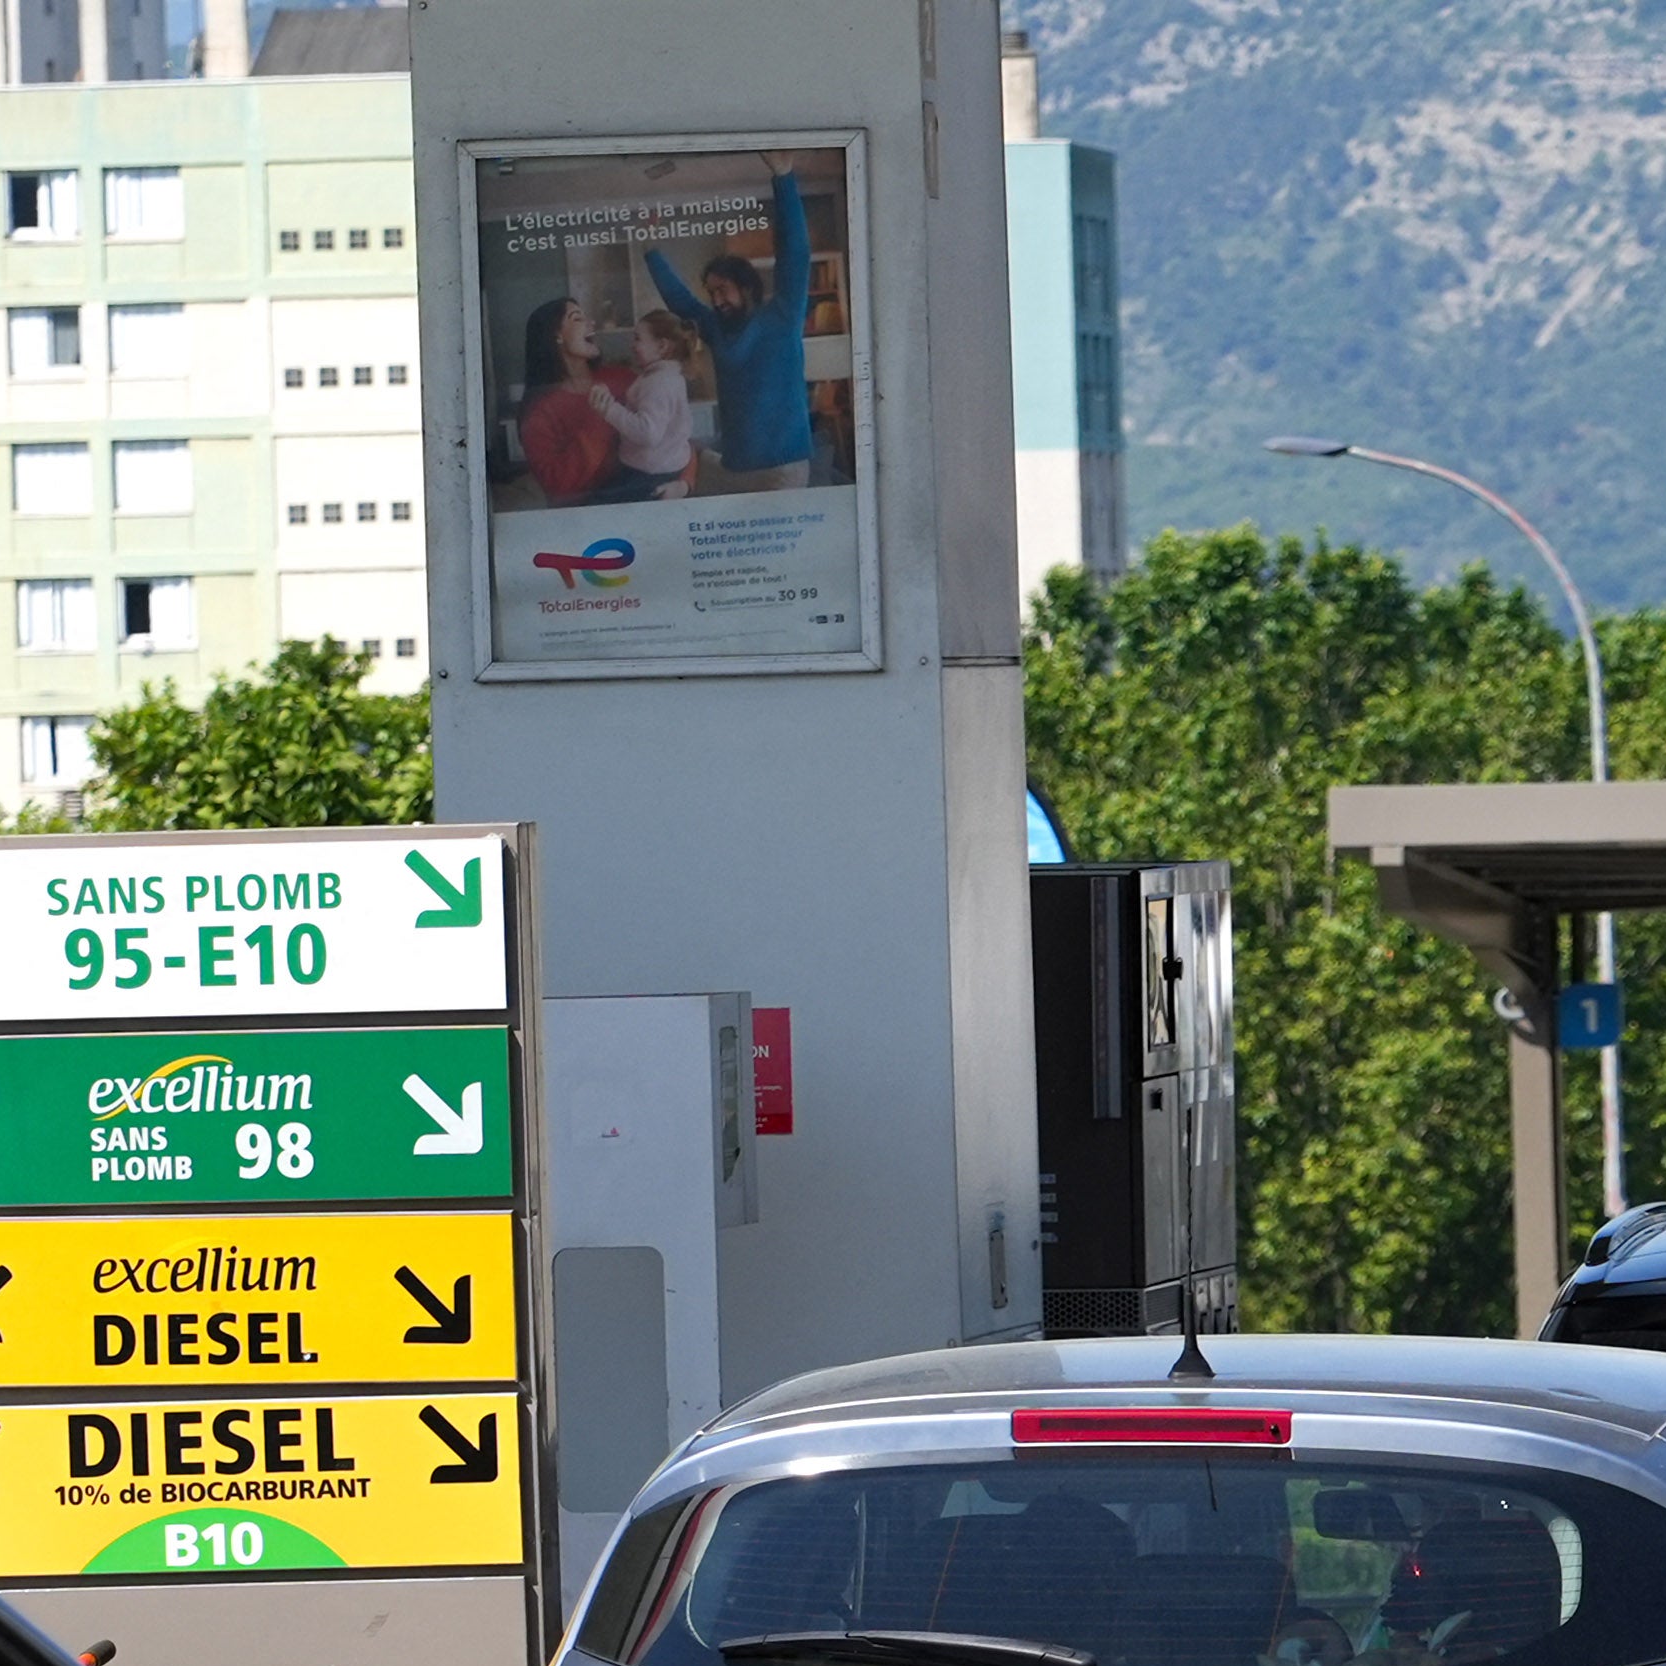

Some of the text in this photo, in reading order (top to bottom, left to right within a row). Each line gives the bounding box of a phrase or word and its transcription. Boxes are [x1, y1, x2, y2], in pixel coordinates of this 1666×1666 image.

[637, 202, 651, 220] à
[656, 201, 676, 218] la
[682, 194, 765, 216] maison,
[563, 226, 617, 249] aussi
[622, 214, 770, 243] TotalEnergies
[688, 521, 702, 532] Et
[718, 519, 748, 530] vous
[689, 529, 804, 547] TotalEnergies pour
[691, 549, 723, 561] votre
[538, 596, 642, 615] TotalEnergies
[778, 588, 797, 602] 30
[800, 586, 819, 600] 99
[45, 872, 343, 917] SANS PLOMB
[63, 922, 328, 992] 95-E10
[1579, 998, 1599, 1034] 1
[88, 1063, 313, 1118] excellium
[90, 1122, 315, 1181] SANS 98
[91, 1155, 194, 1183] PLOMB
[92, 1246, 317, 1294] excellium
[92, 1311, 320, 1367] DIESEL
[67, 1407, 356, 1479] DIESEL
[54, 1478, 371, 1506] 10% de BIOCARBURANT
[164, 1521, 265, 1568] B10
